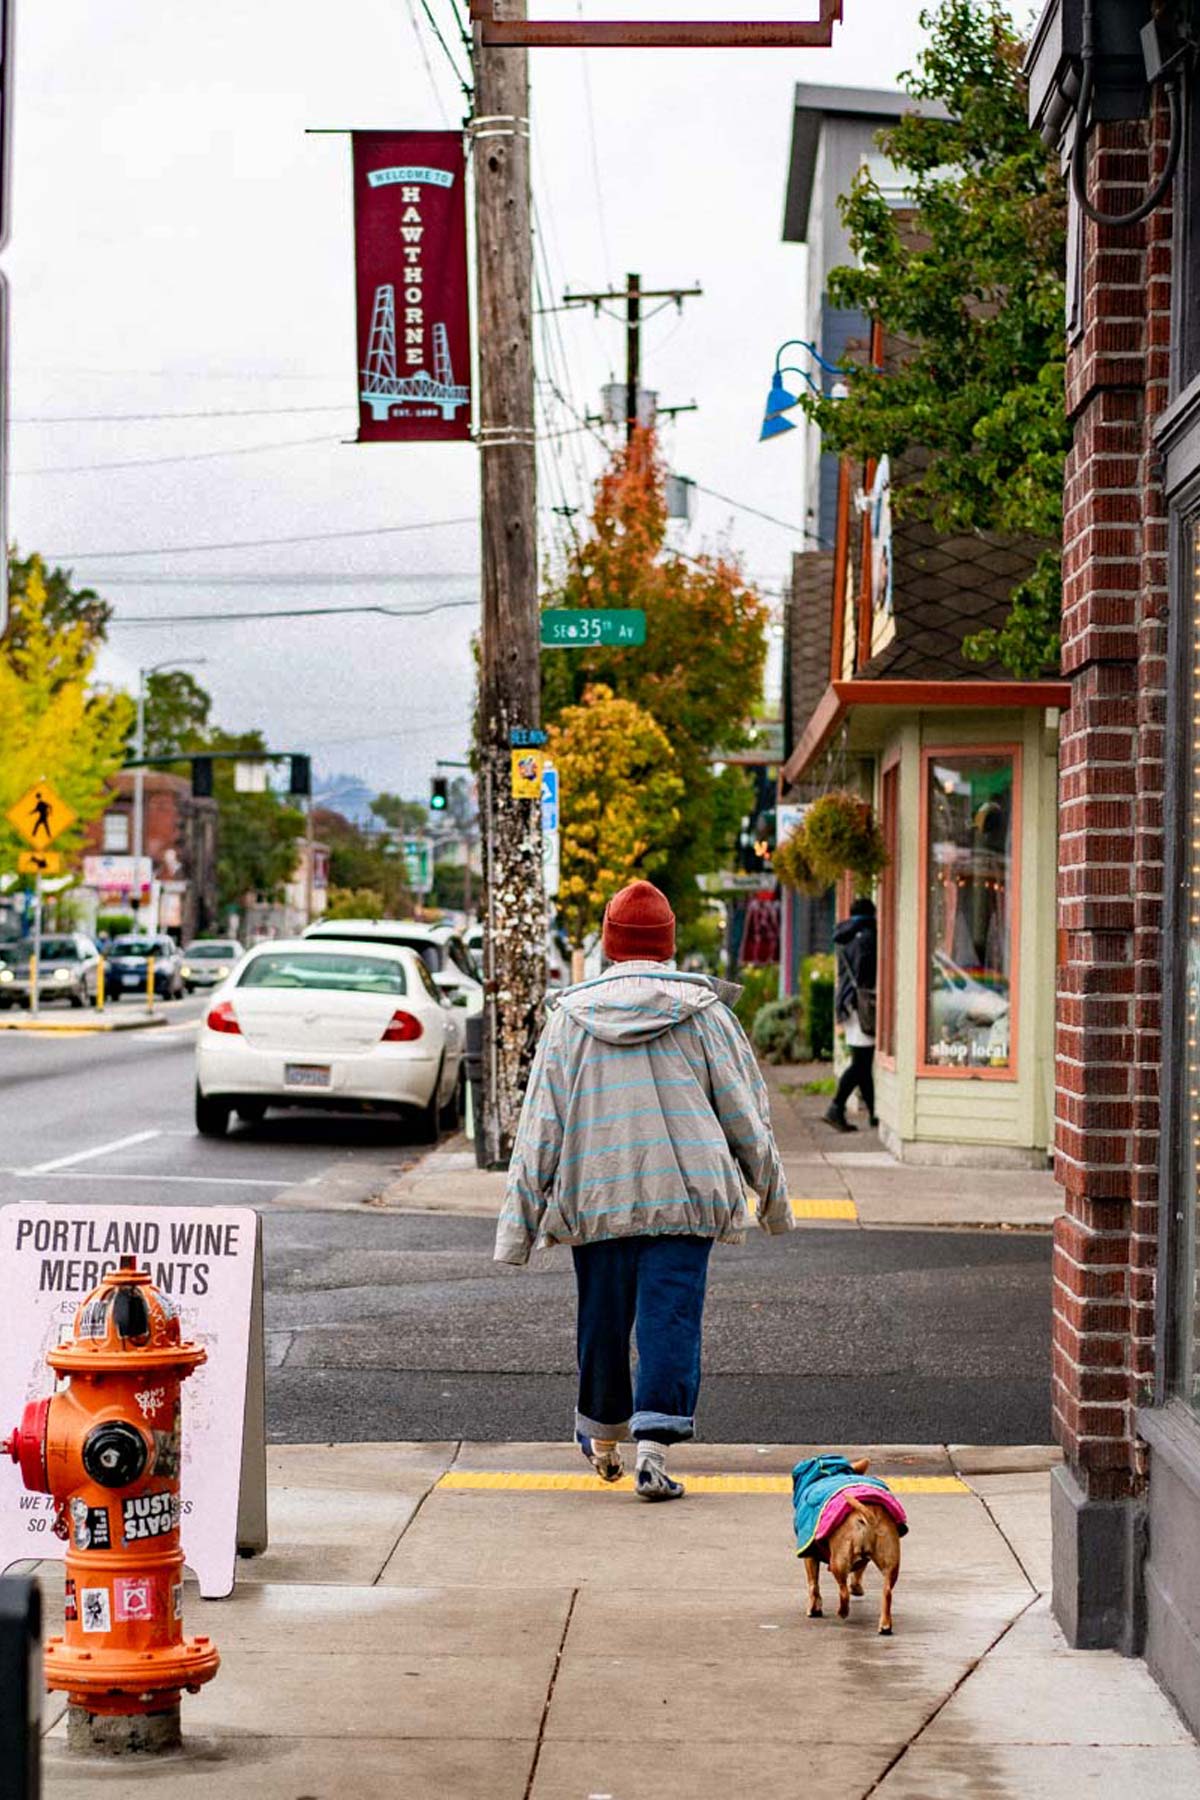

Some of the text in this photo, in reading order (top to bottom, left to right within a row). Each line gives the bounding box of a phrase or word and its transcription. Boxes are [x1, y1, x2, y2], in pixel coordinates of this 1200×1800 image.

[375, 169, 450, 184] WELCOME TO
[400, 186, 425, 365] HAWTHORNE
[553, 624, 568, 638] SE
[930, 1040, 1008, 1062] shop local
[16, 1219, 240, 1257] PORTLAND WINE
[39, 1259, 210, 1295] MERCNTS
[19, 1496, 42, 1510] WE
[124, 1492, 170, 1519] JUST
[27, 1518, 47, 1533] SO
